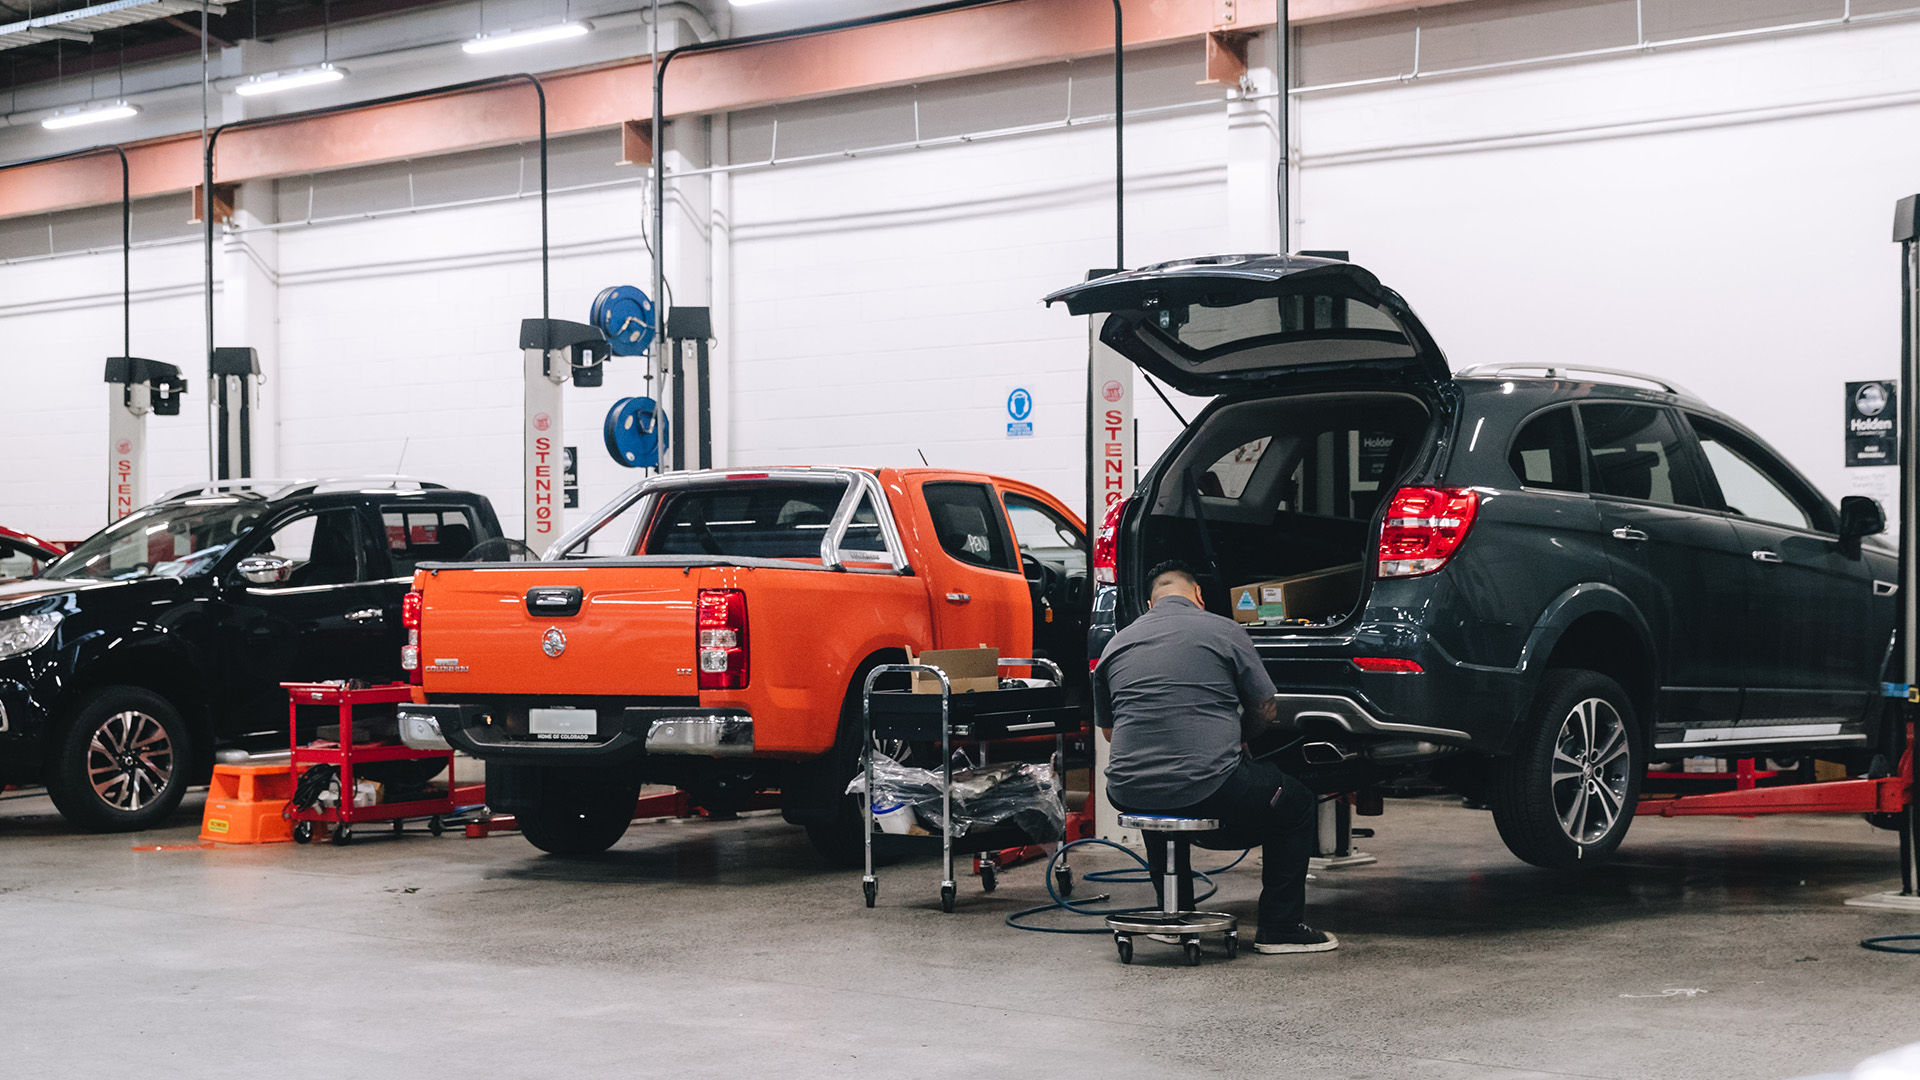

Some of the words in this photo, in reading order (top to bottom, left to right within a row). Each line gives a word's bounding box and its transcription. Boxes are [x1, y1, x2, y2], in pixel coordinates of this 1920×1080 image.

[1850, 417, 1893, 432] Holden
[1105, 410, 1123, 506] STENHØ
[118, 460, 131, 519] STENH
